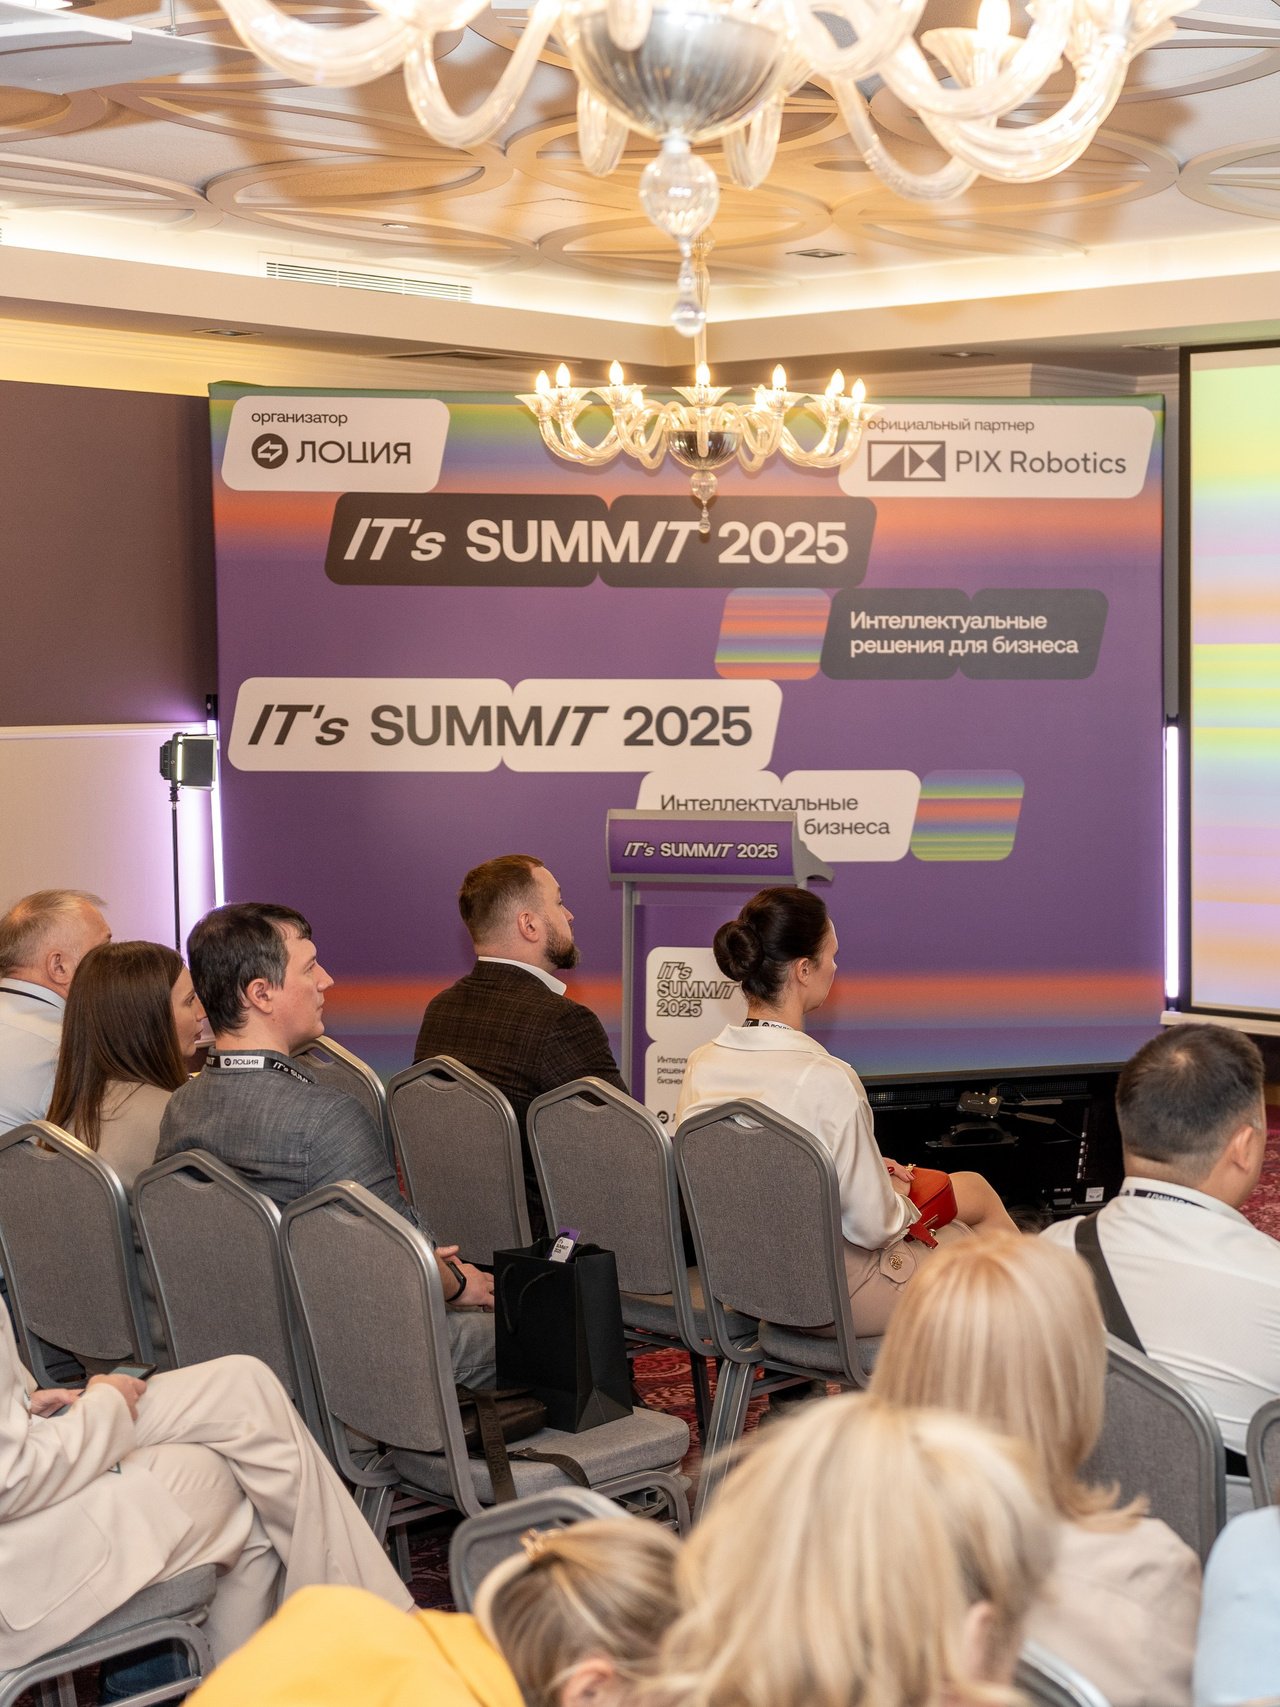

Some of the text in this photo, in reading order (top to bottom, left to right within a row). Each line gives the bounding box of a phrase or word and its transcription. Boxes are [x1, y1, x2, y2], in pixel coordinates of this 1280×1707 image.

[251, 411, 348, 427] организатор
[867, 418, 1035, 434] официальный партнер
[296, 440, 411, 465] ЛОЦИЯ
[956, 450, 1127, 474] PIX Robotics
[343, 517, 850, 565] IT's SUMMIT 2025
[850, 611, 1048, 633] Интеллектуальные
[850, 634, 1079, 658] решения для бизнеса
[247, 704, 753, 747] IT's SUMMIT 2025
[661, 794, 858, 812] Интеллектуальные
[804, 818, 890, 835] бизнеса
[622, 841, 779, 859] IT's SUMMIT 2025
[657, 961, 692, 979] IT's
[657, 980, 740, 999] SUMMIT
[657, 999, 702, 1017] 2025
